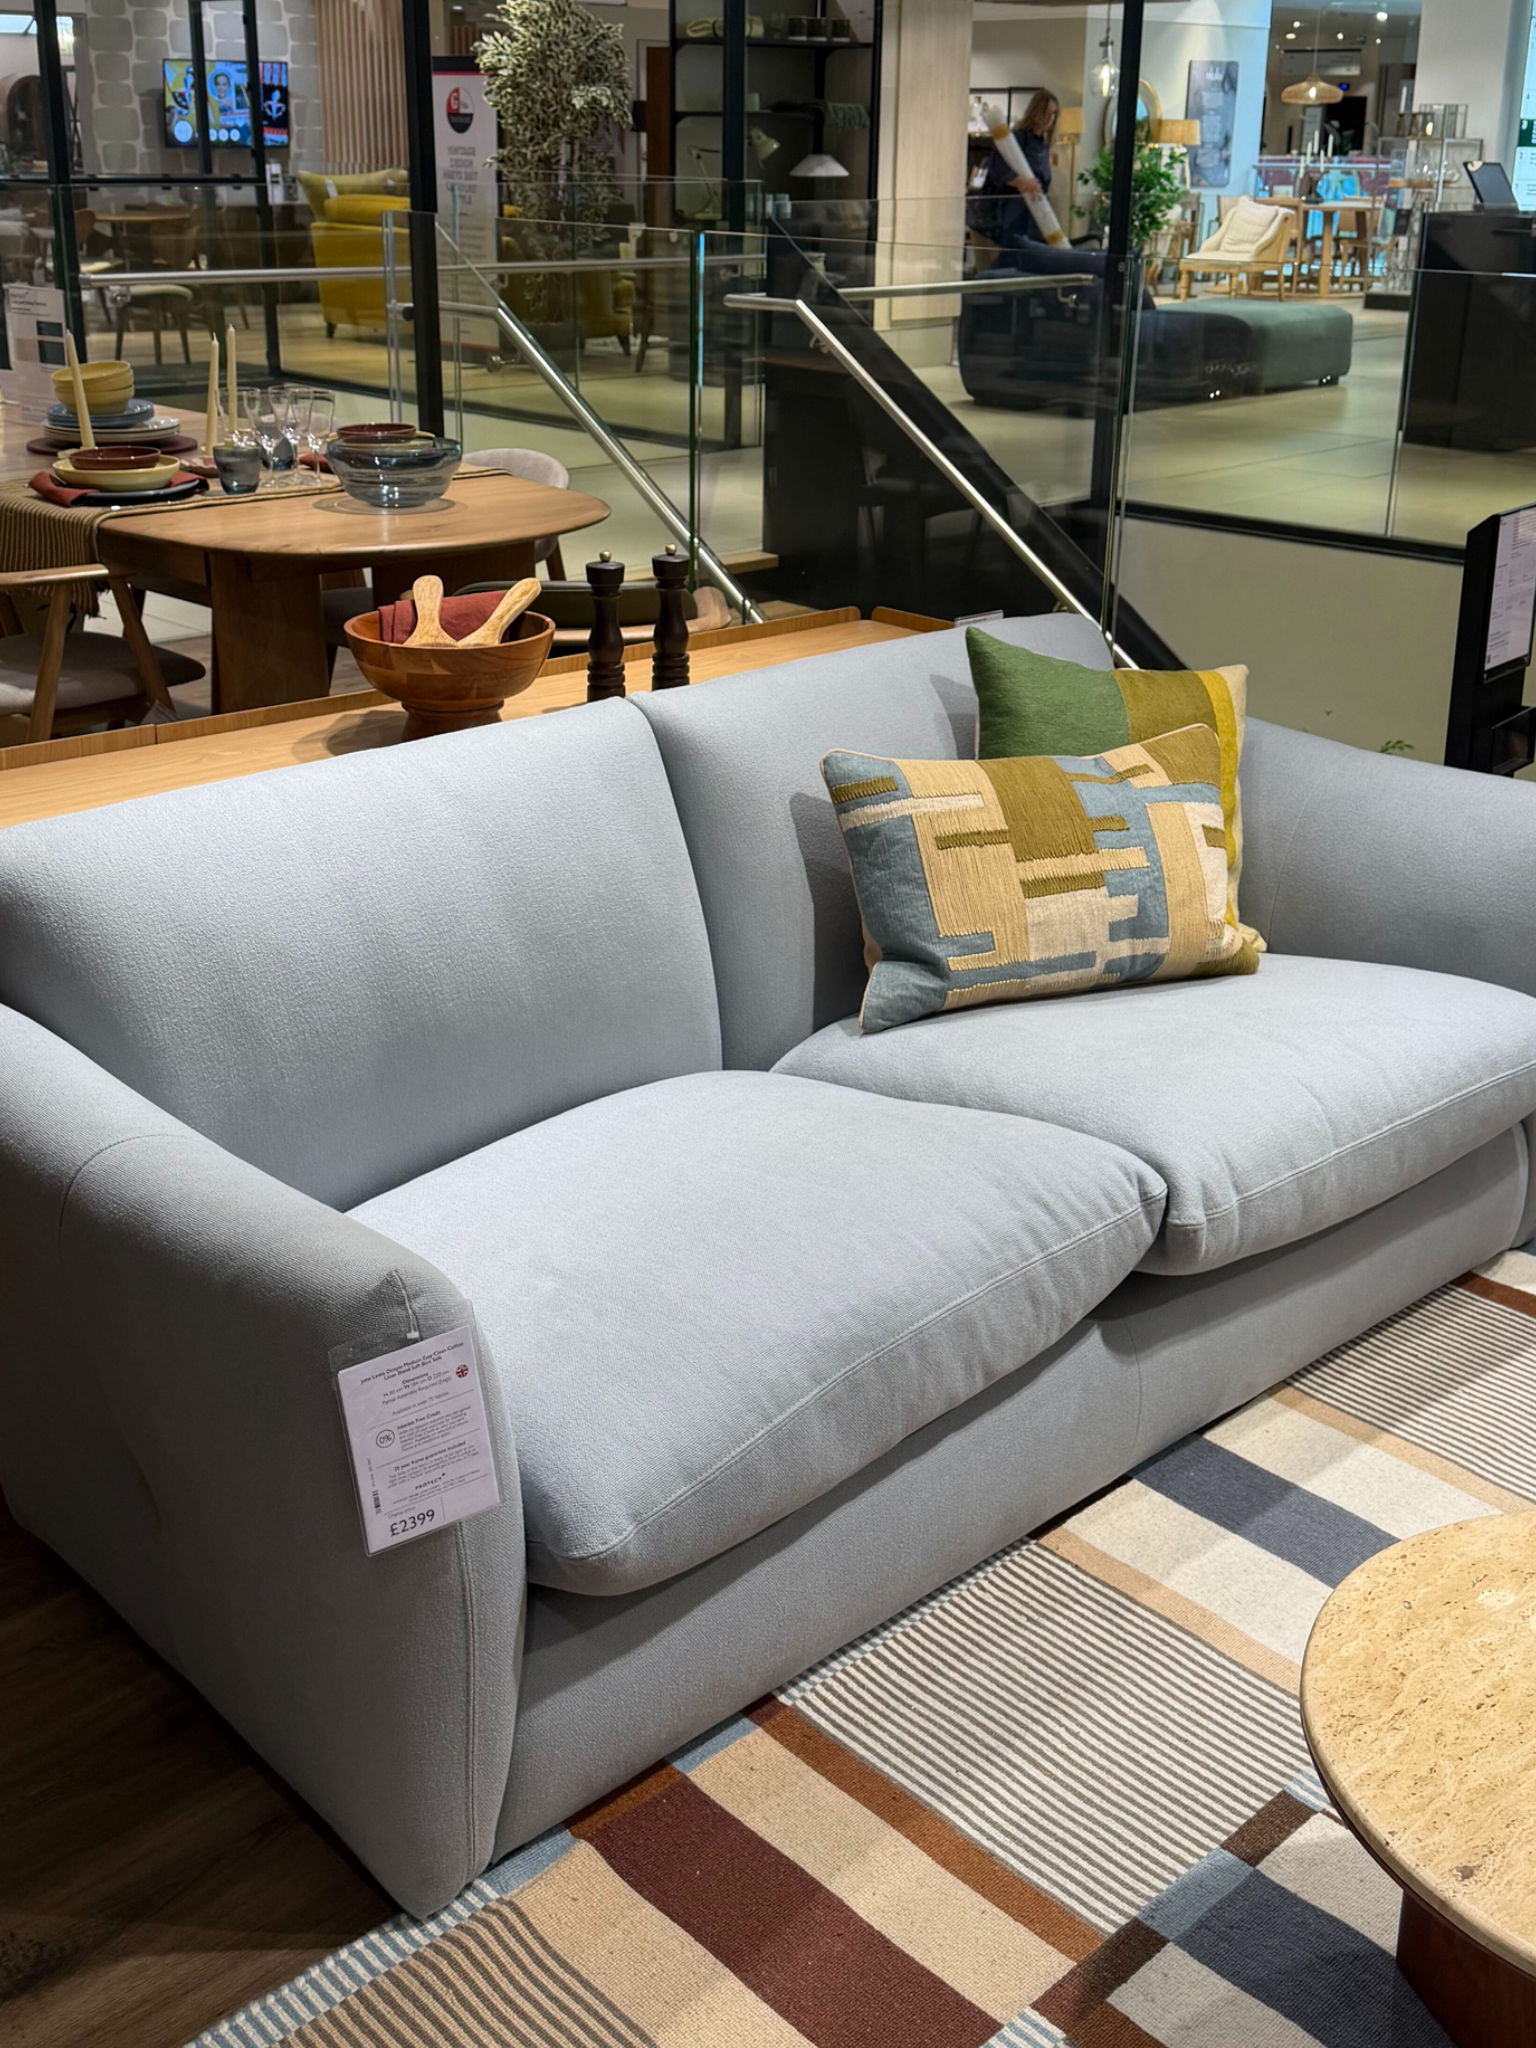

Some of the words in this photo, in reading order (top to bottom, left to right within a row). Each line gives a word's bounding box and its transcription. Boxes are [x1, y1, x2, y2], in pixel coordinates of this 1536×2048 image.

[386, 1366, 402, 1374] Dimple
[447, 1342, 464, 1350] Cotton
[402, 1373, 428, 1384] Dimensions
[397, 1421, 414, 1429] Interest
[379, 1435, 391, 1444] 0%
[425, 1449, 446, 1460] guarantee
[447, 1441, 465, 1450] included
[390, 1509, 434, 1536] £2399
